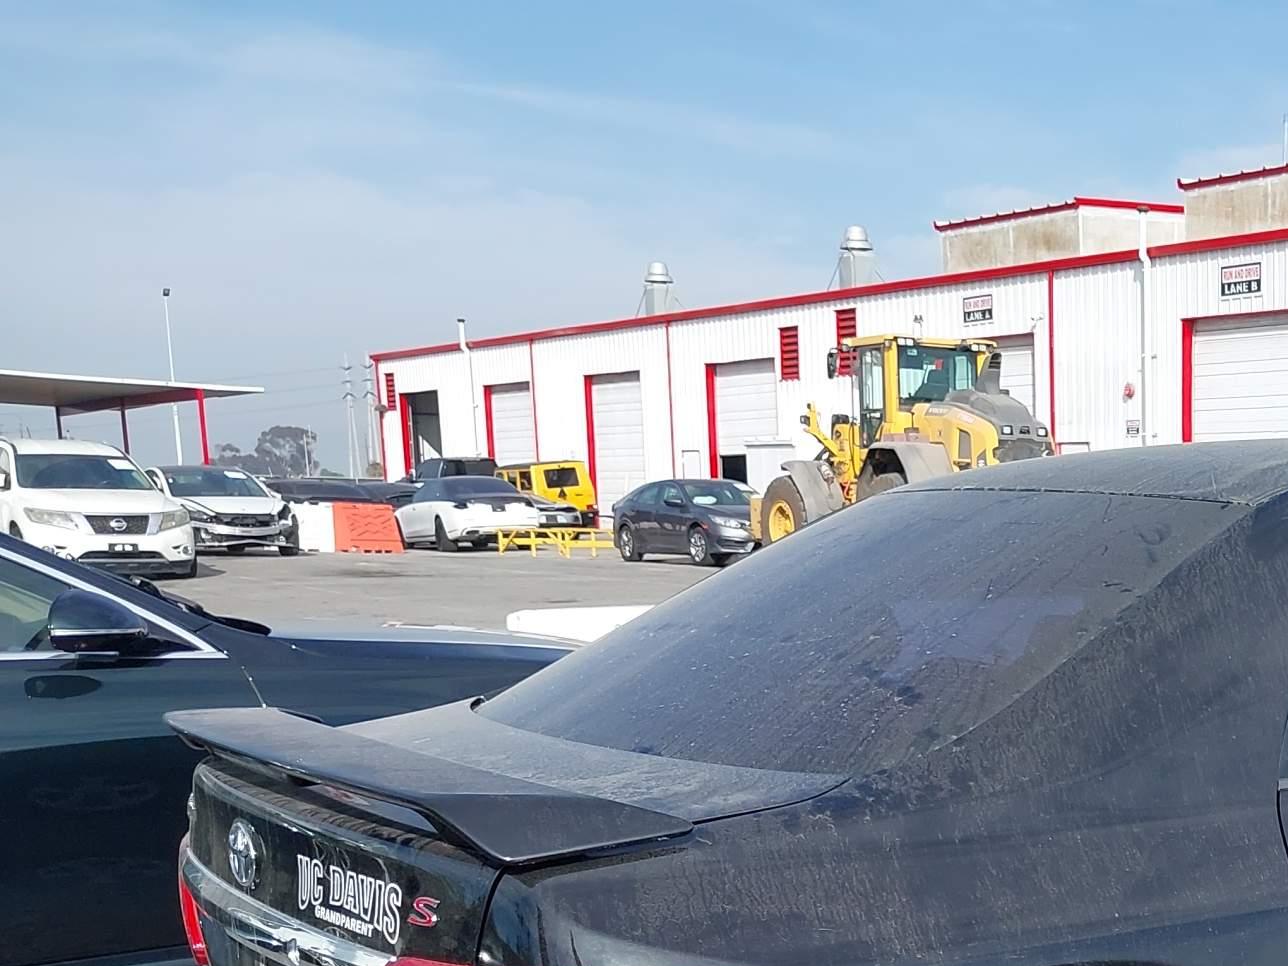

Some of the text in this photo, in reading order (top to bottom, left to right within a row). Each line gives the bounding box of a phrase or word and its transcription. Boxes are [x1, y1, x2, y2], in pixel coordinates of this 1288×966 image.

[1224, 281, 1258, 294] LANE B
[965, 311, 984, 321] LANE
[297, 854, 403, 945] UC DAVIS
[406, 896, 441, 927] S
[314, 905, 375, 938] GRANDPARENT
